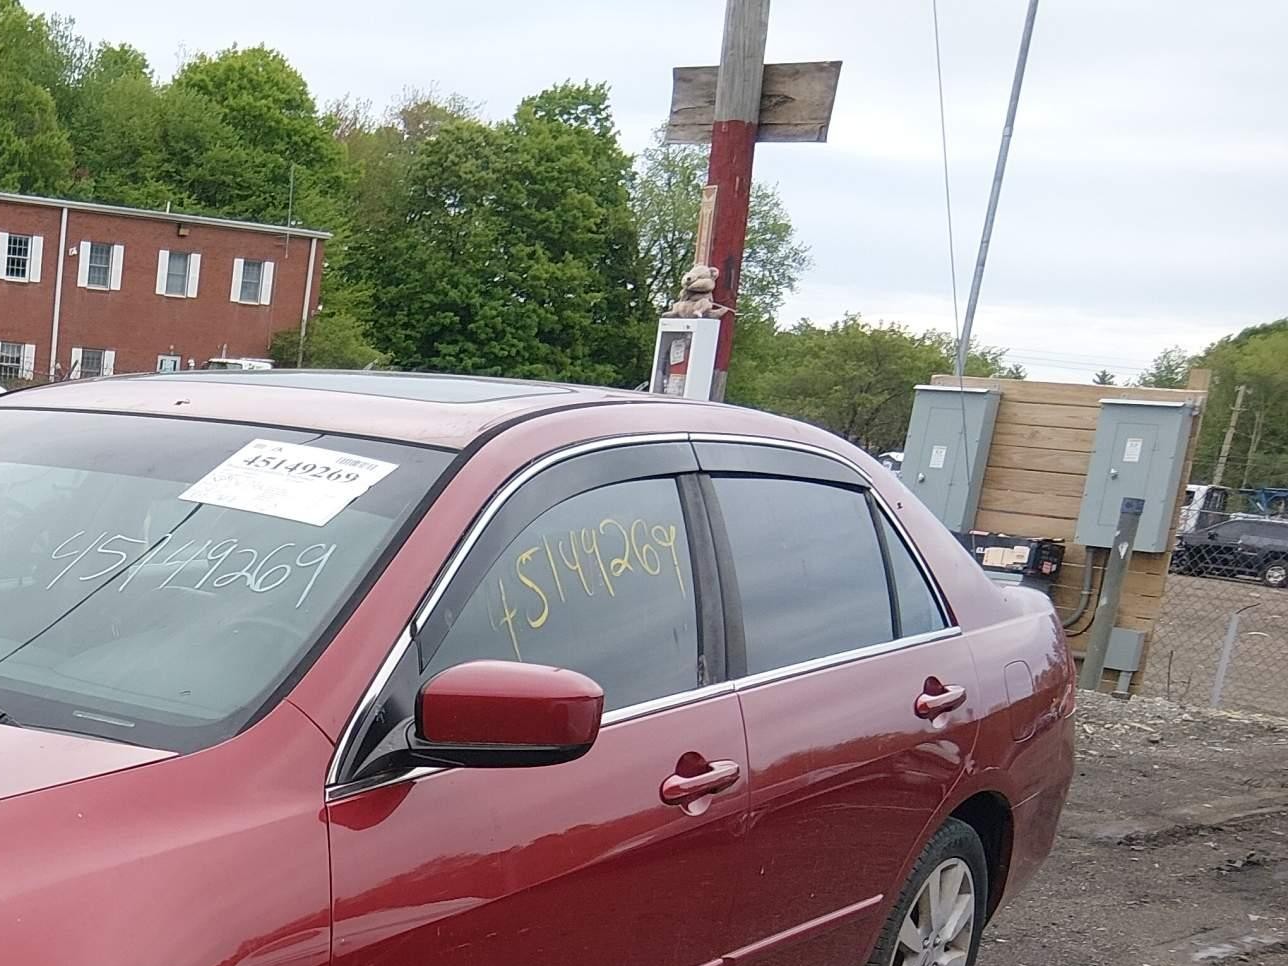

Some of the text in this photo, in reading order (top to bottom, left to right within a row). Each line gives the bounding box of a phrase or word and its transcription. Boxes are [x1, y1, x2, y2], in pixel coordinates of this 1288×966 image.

[243, 454, 360, 483] 45149269
[45, 530, 337, 609] 45149269
[487, 519, 687, 662] 45149269
